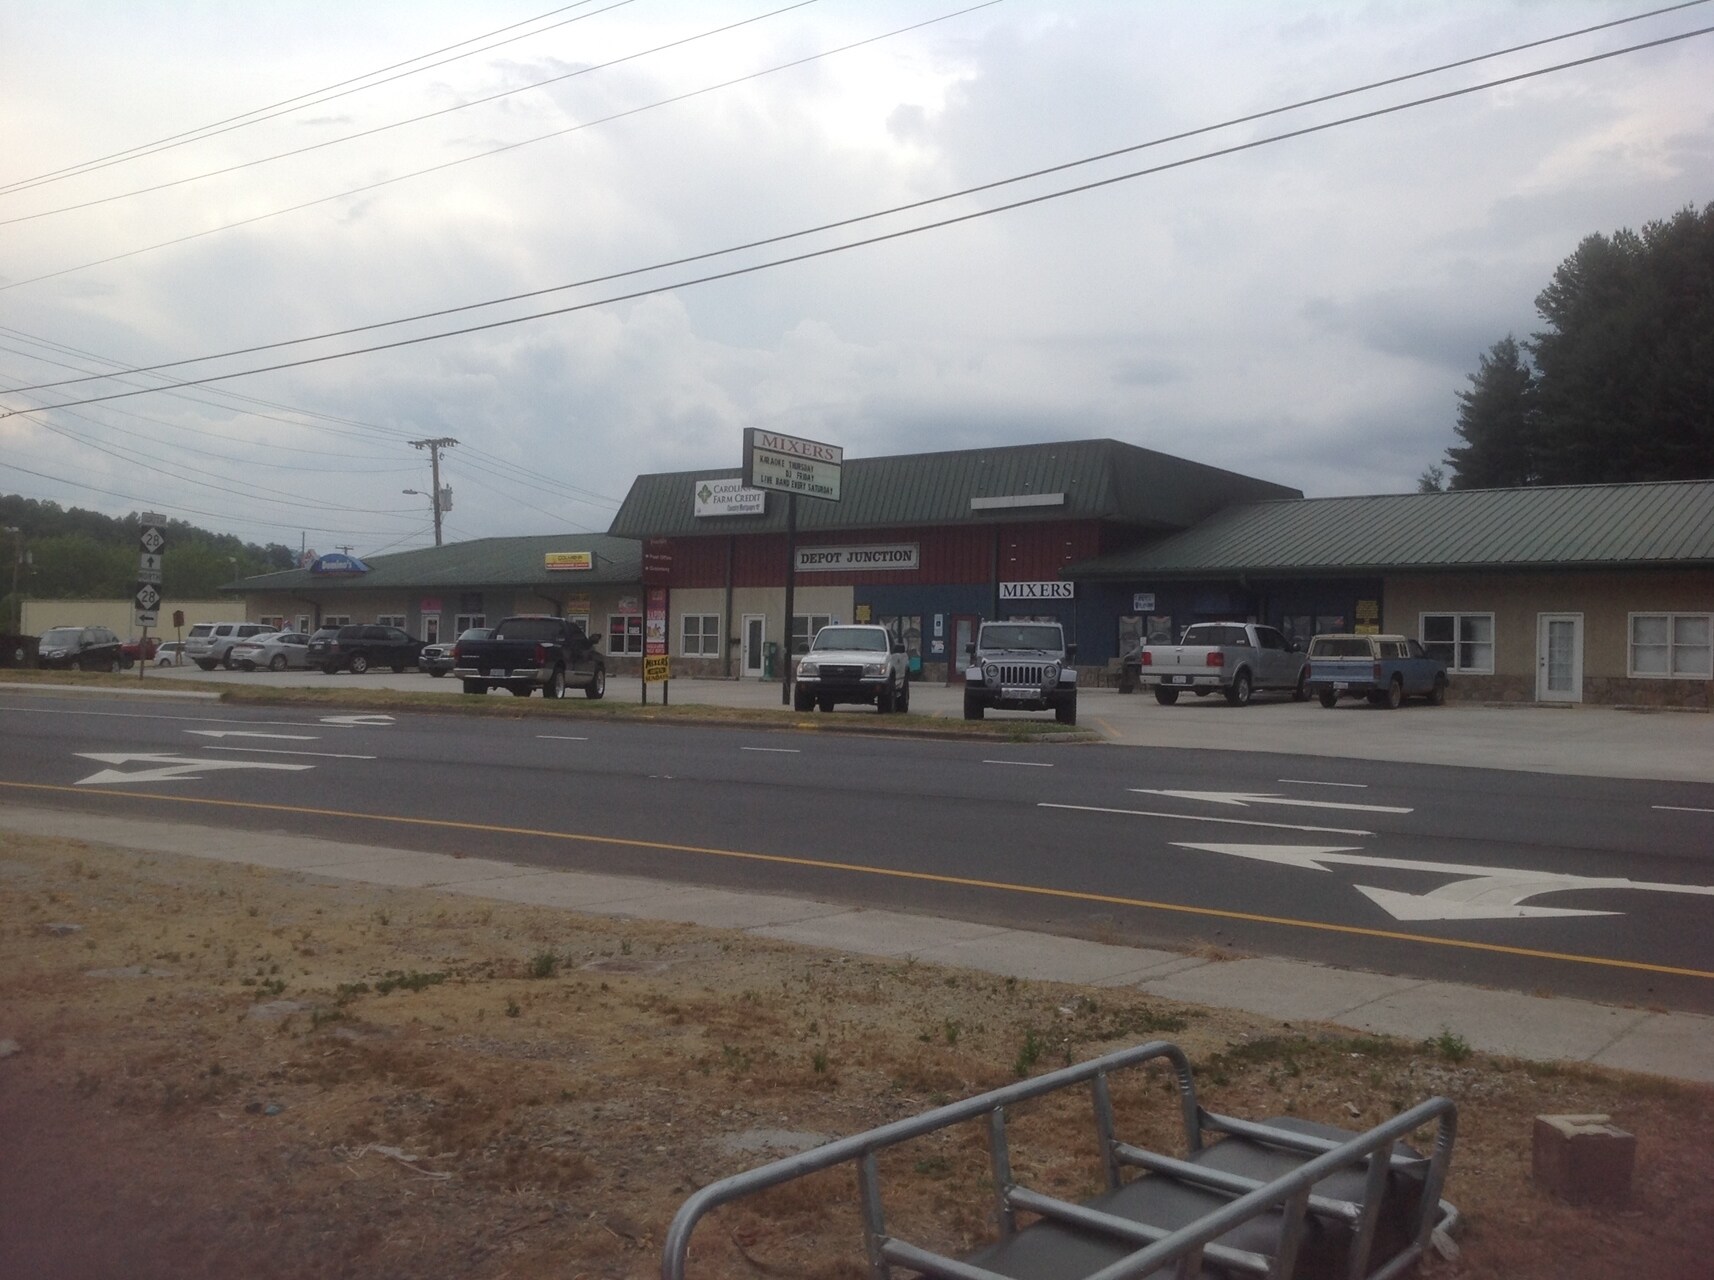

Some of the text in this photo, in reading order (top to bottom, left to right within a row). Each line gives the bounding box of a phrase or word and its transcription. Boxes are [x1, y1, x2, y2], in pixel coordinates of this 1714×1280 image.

[762, 433, 834, 460] MIXERS
[759, 455, 814, 473] KARAOKE THURSDAY
[785, 470, 814, 482] DJ FRIDAY
[760, 474, 833, 495] LIVE BAND EVERY SATURDAY
[713, 493, 761, 504] FARM CREDIT
[146, 533, 160, 546] 28
[800, 550, 913, 564] DEPOT JUNCTION
[141, 590, 156, 603] 28
[1002, 582, 1072, 597] MIXERS
